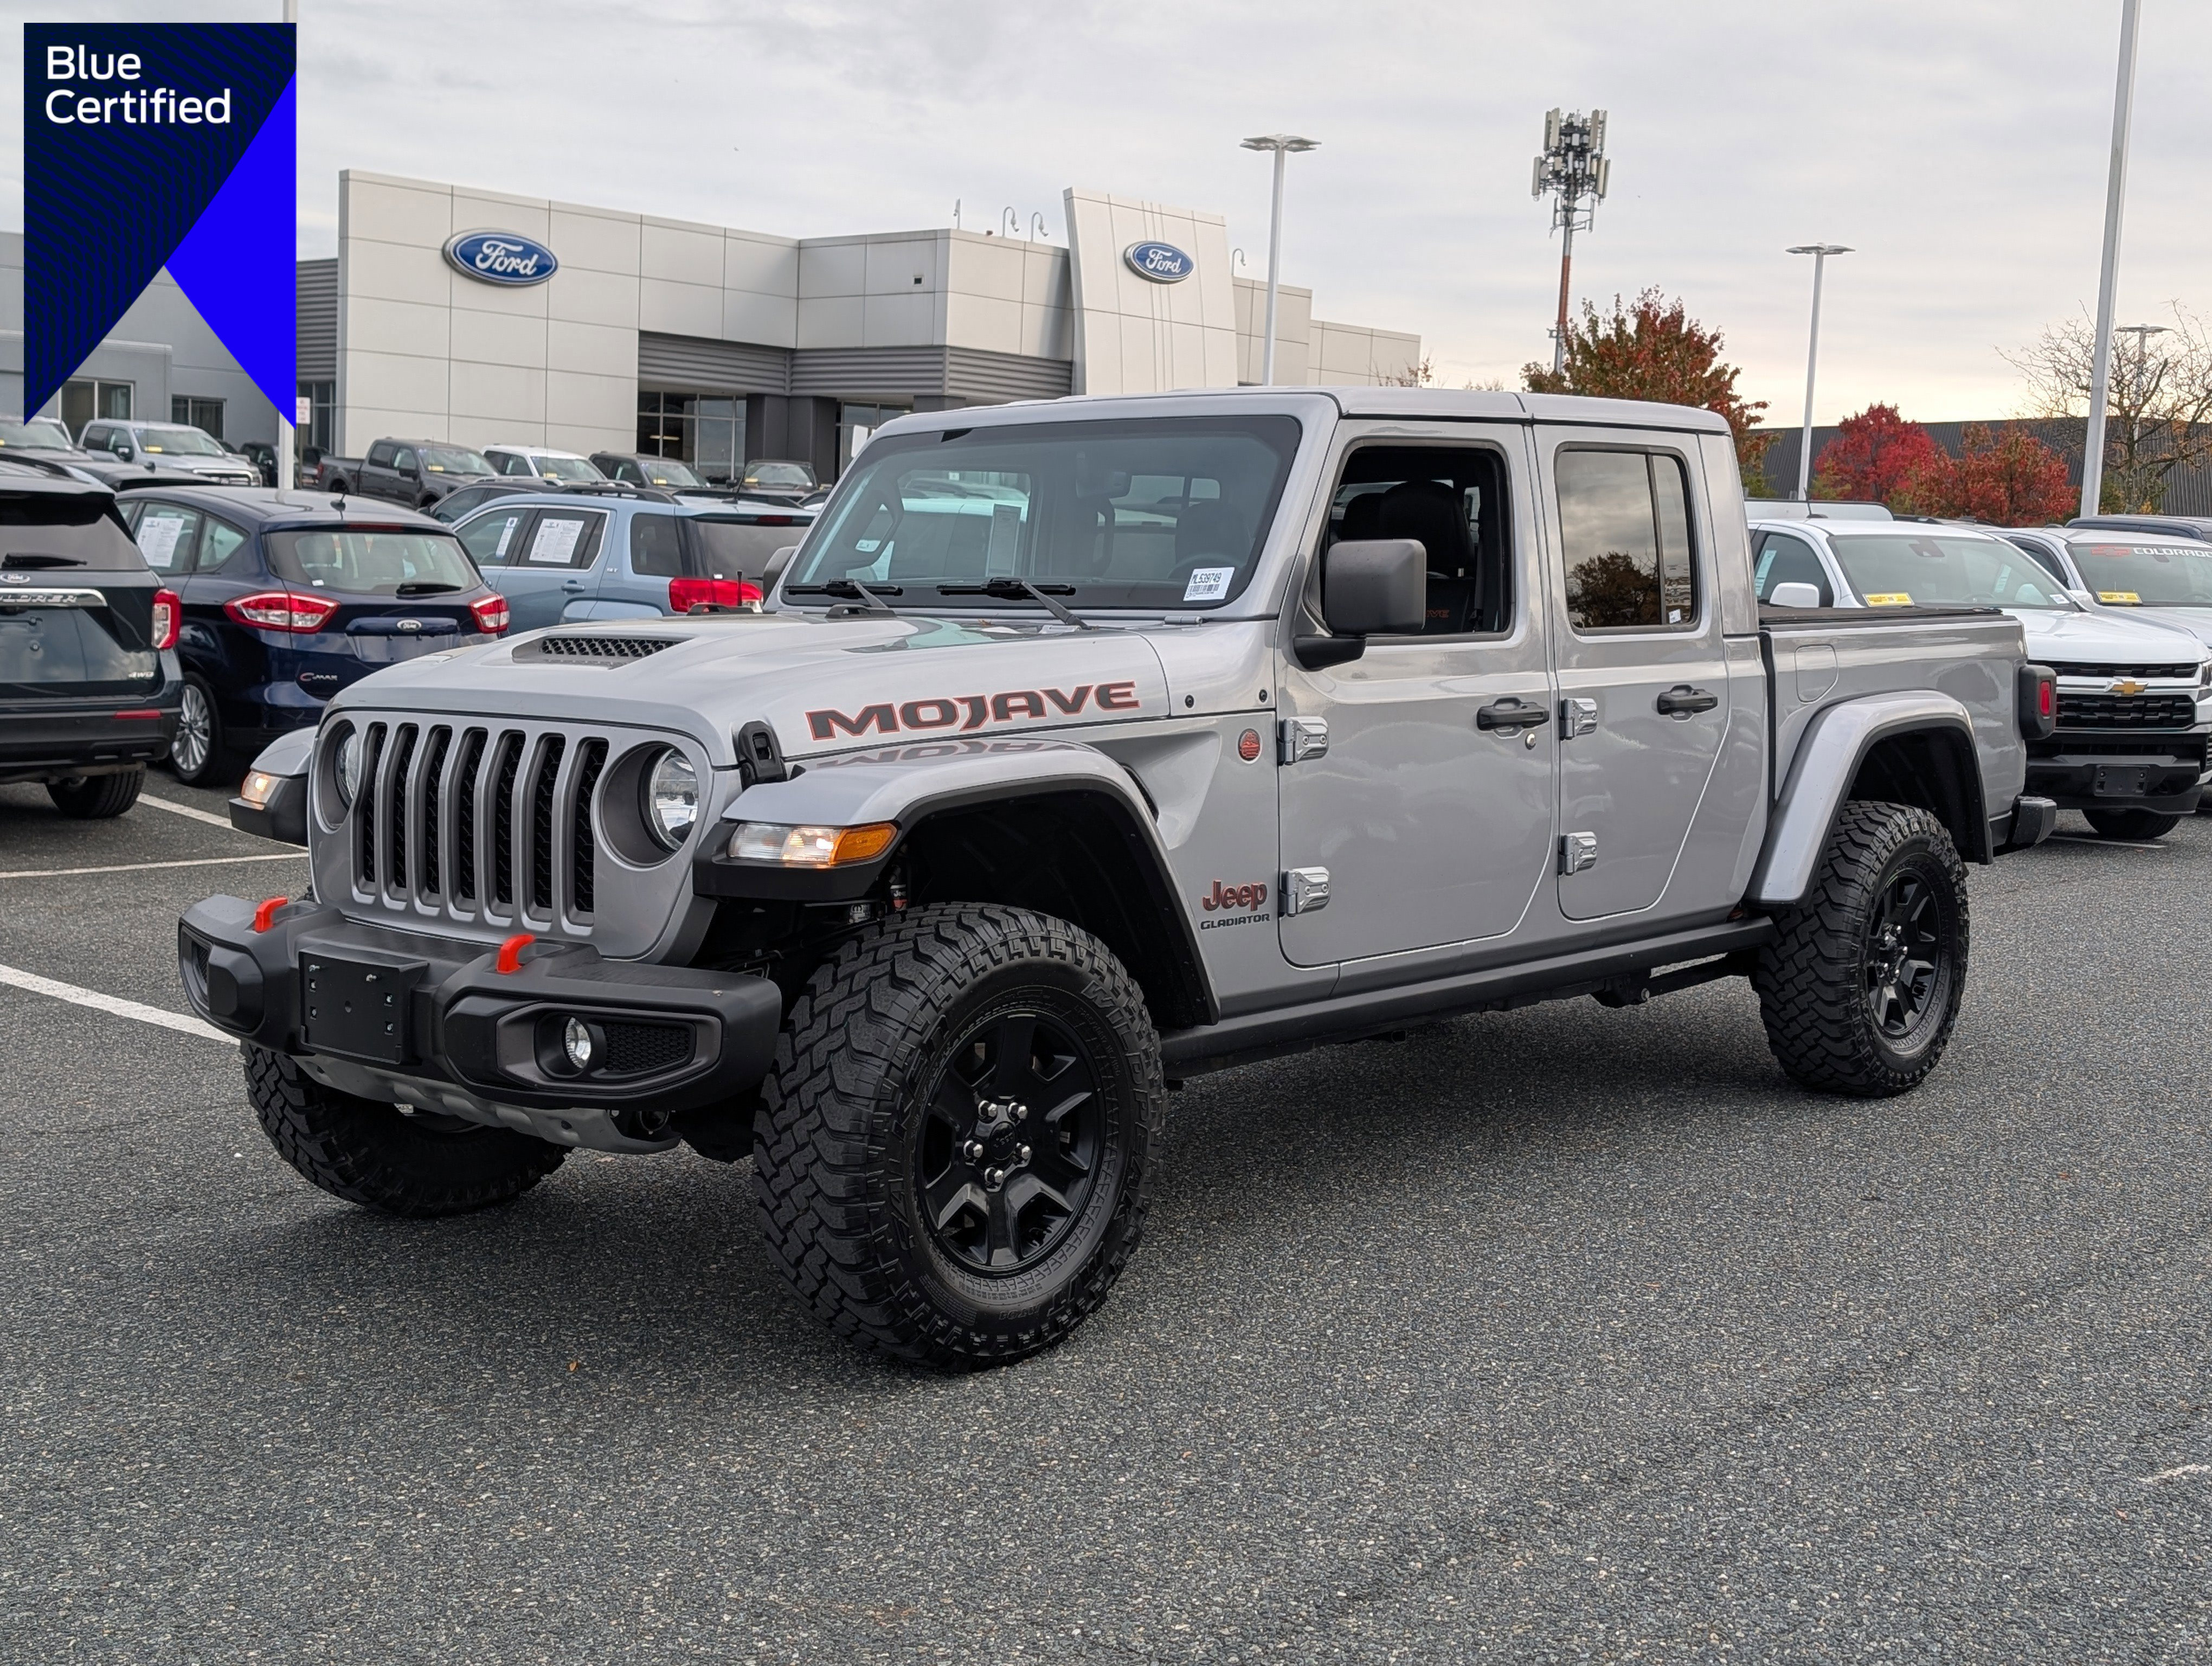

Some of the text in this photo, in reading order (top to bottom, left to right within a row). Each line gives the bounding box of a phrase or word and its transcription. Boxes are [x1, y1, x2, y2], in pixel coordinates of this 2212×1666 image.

[475, 240, 538, 275] Ford
[1146, 248, 1182, 273] Ford
[2133, 547, 2212, 558] COLORADO
[805, 681, 1141, 741] MOJAVE
[1203, 879, 1268, 912] Jeep
[1200, 913, 1270, 930] GLADIATOR
